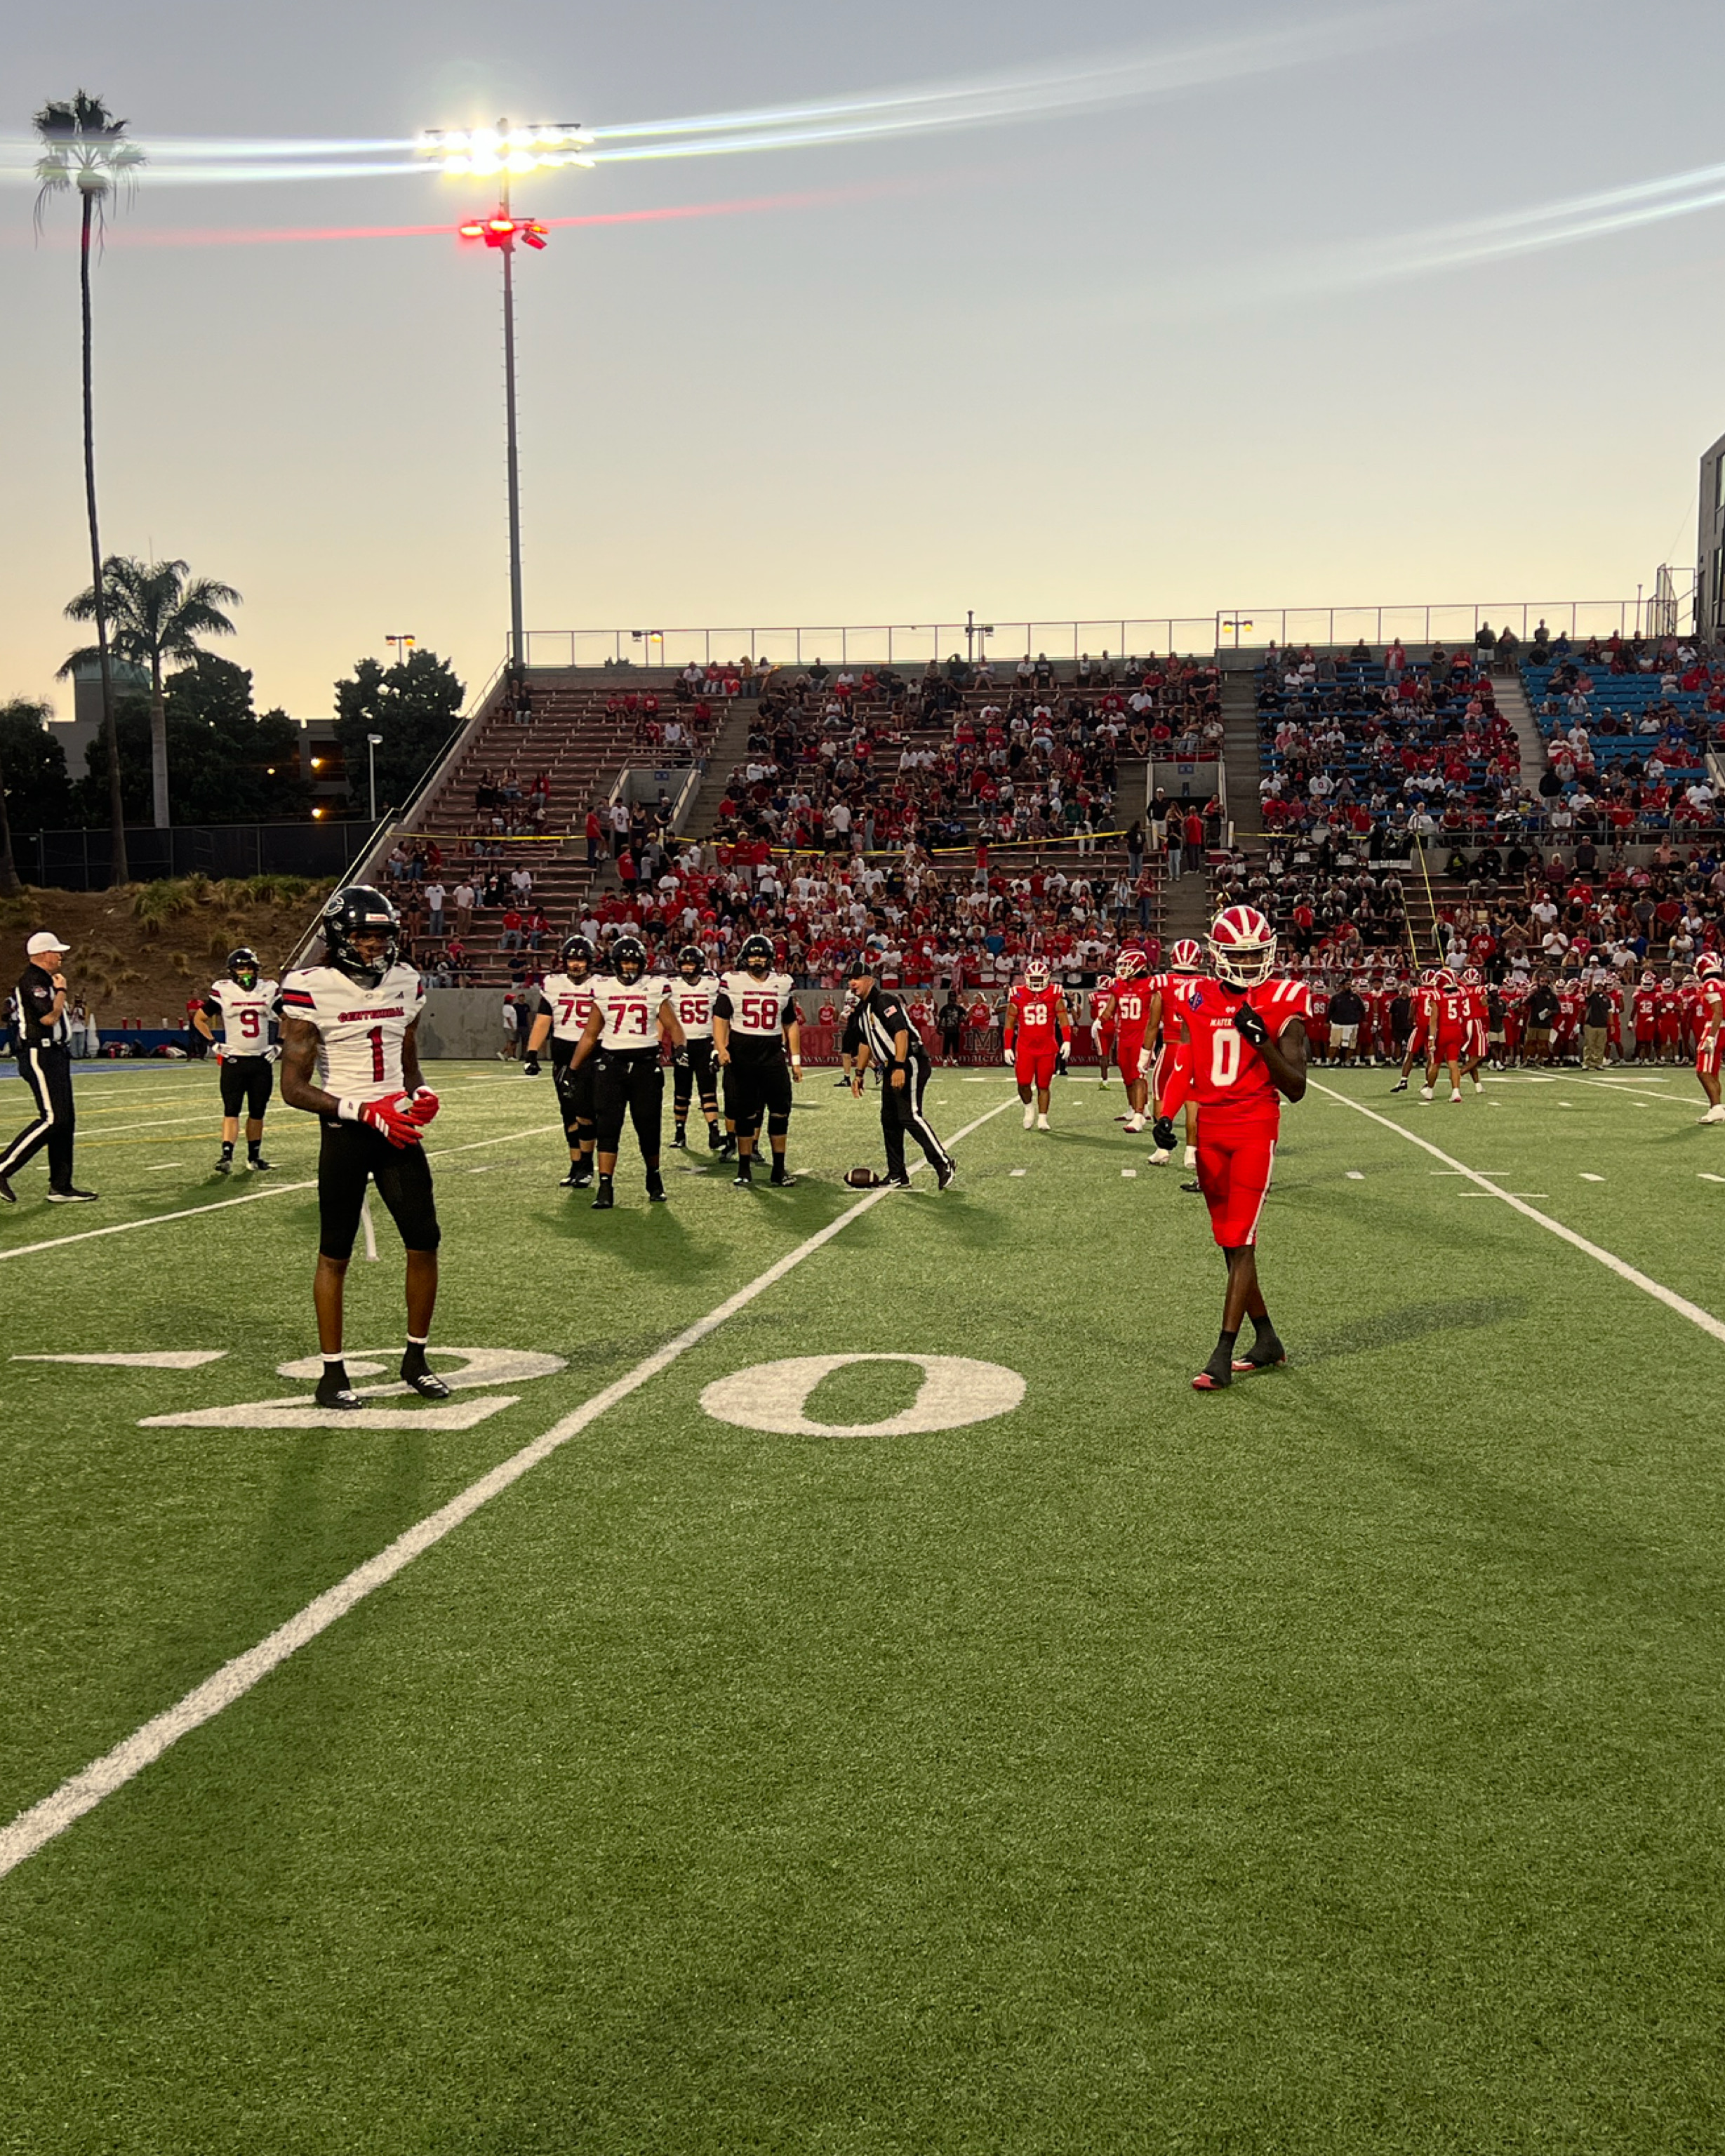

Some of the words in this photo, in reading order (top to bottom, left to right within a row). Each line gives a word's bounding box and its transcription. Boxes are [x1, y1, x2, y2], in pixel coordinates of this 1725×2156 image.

[607, 1004, 648, 1035] 73
[679, 999, 710, 1025] 65
[742, 998, 779, 1030] 58
[1023, 1004, 1048, 1025] 58
[1119, 997, 1142, 1020] 50
[1447, 999, 1458, 1020] 5
[1639, 1001, 1653, 1013] 32
[240, 1009, 260, 1039] 9
[366, 1025, 385, 1083] 1
[1209, 1028, 1241, 1087] 0
